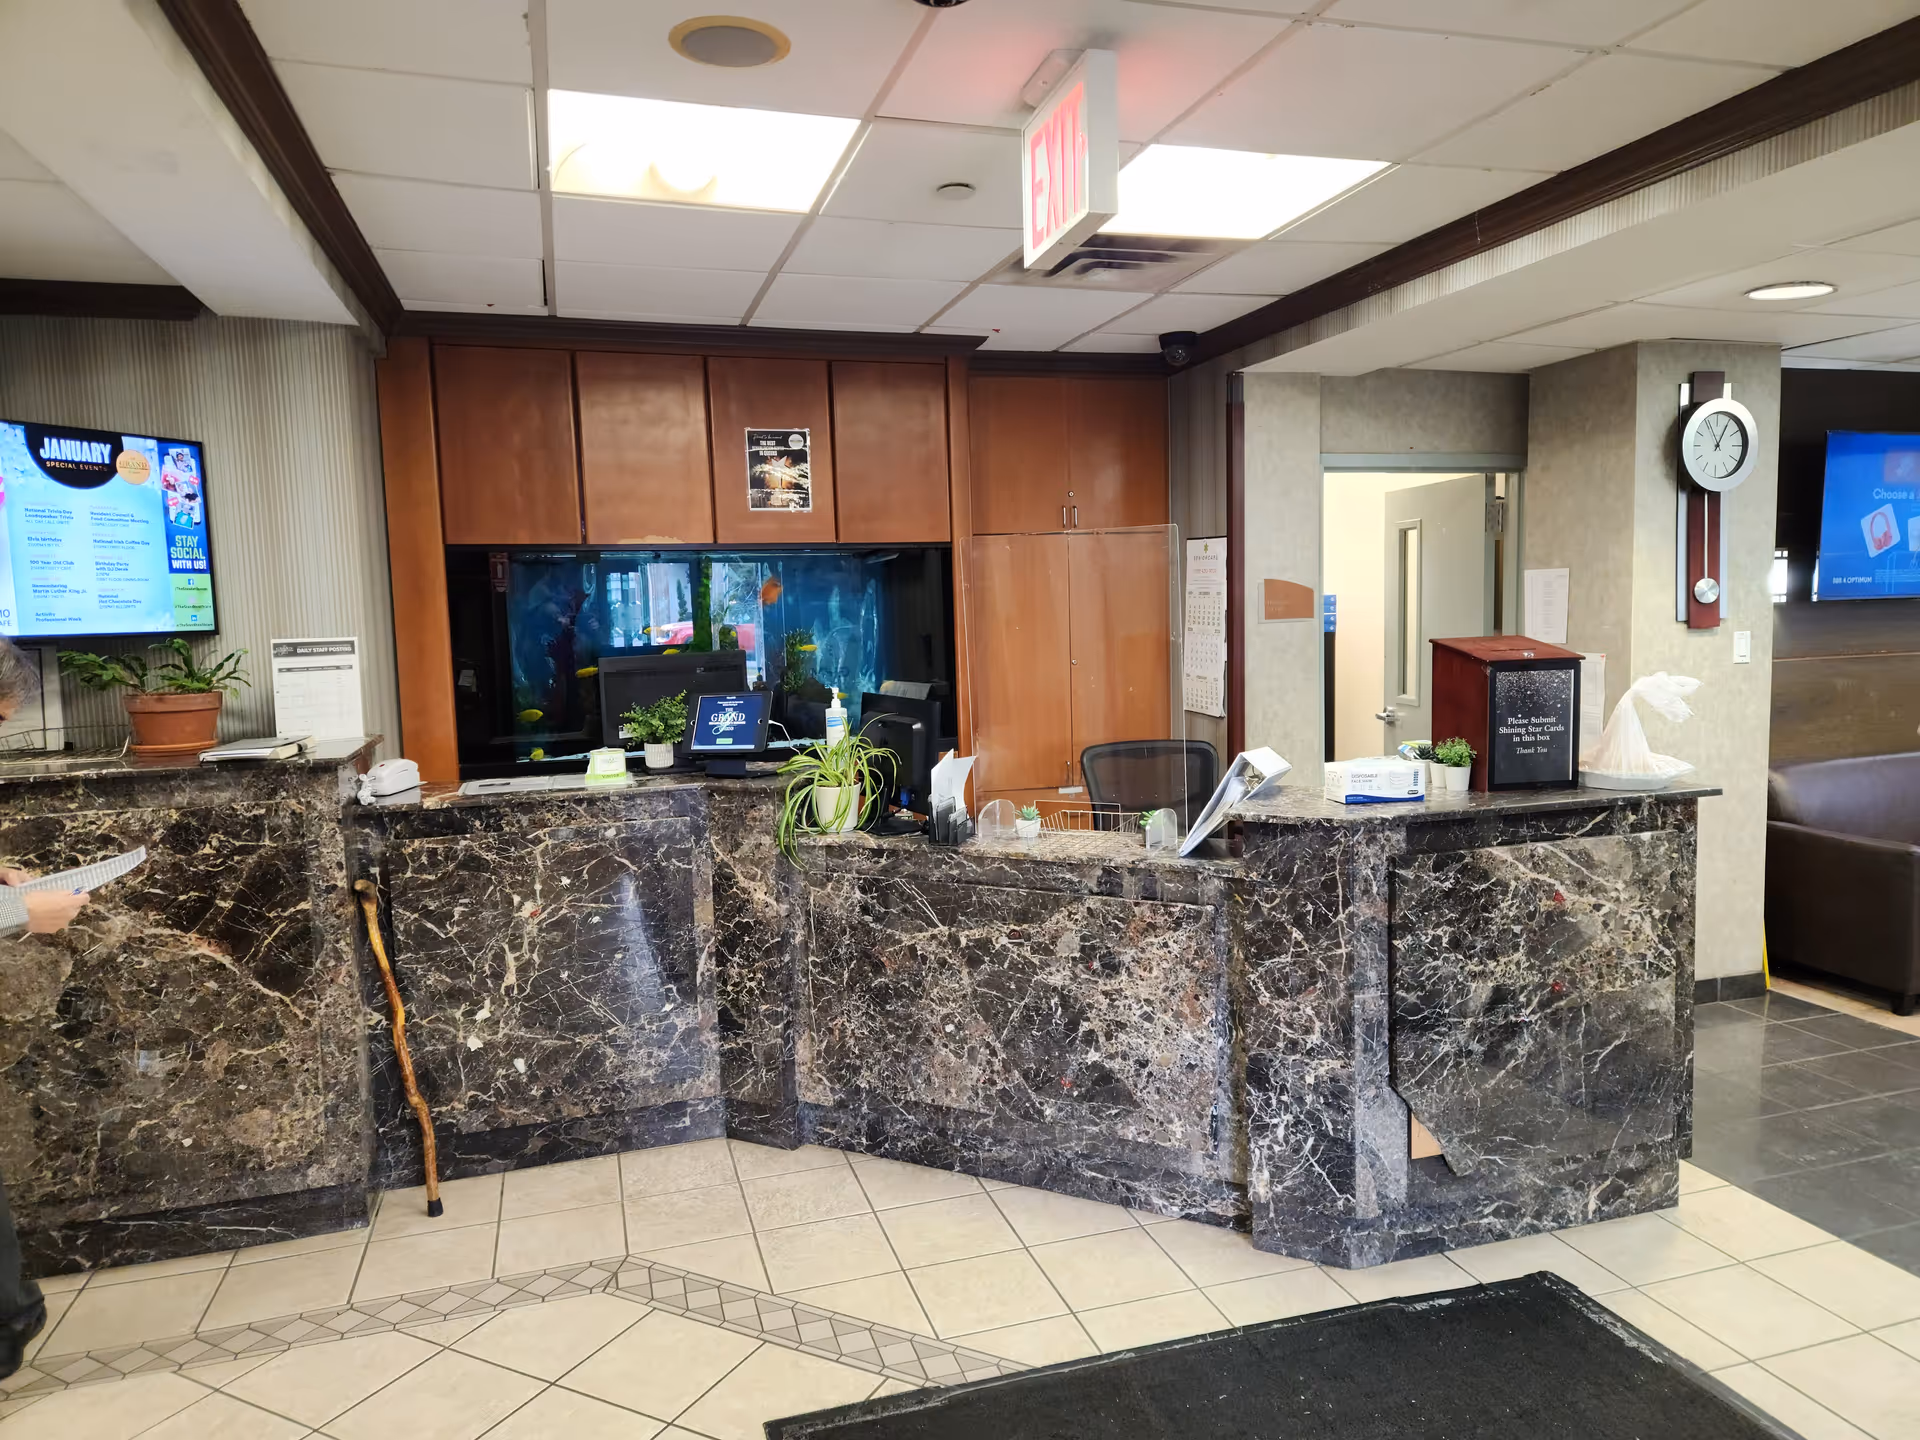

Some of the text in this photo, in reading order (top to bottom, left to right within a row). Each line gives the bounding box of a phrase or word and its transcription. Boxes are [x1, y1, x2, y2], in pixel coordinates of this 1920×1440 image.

[1031, 82, 1083, 250] EXIT
[40, 436, 112, 464] JANUARY
[45, 461, 77, 469] SPECIAL
[1872, 488, 1908, 499] Choose
[175, 535, 198, 547] STAY
[170, 547, 206, 559] SOCIAL
[171, 560, 207, 570] WITH US!
[1847, 576, 1872, 584] OPTIMUM
[711, 712, 746, 722] GRAND
[1507, 716, 1556, 725] Please Submit
[1499, 724, 1565, 735] Shining Star Cards
[1522, 734, 1536, 742] this
[1537, 733, 1551, 741] box
